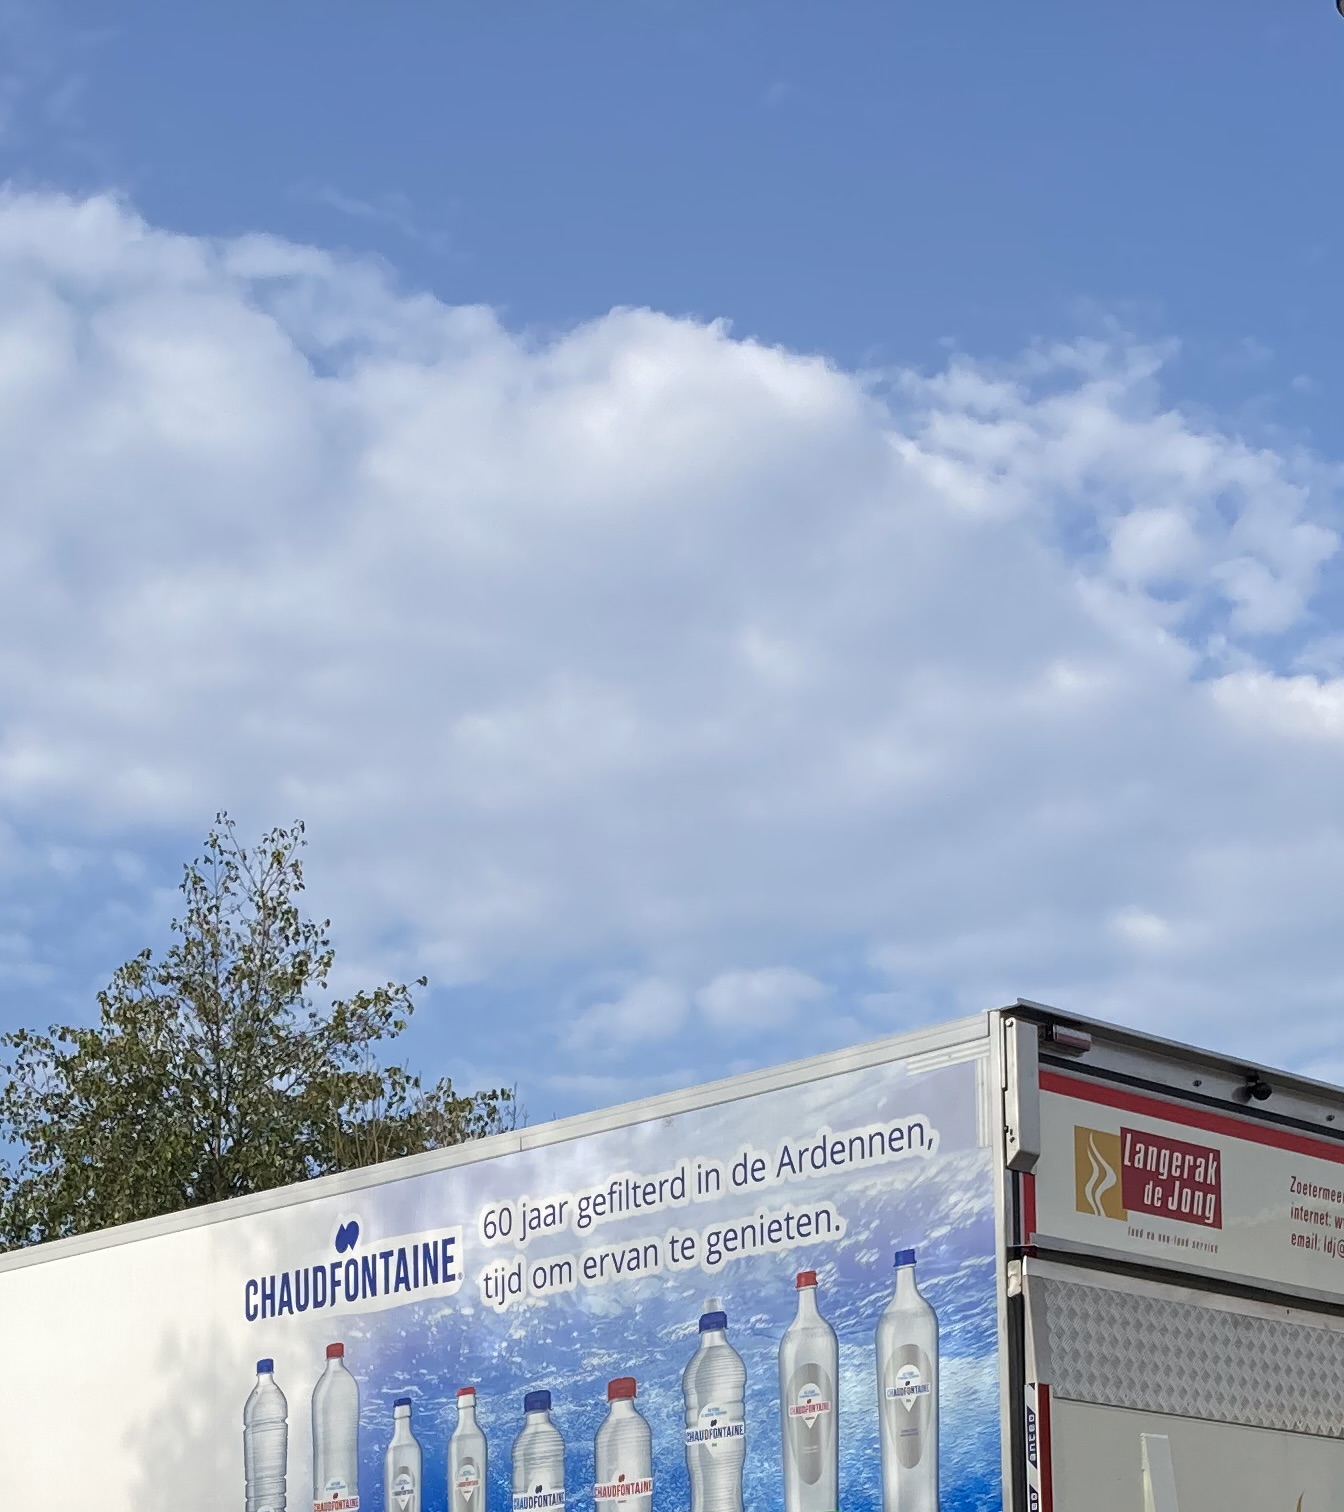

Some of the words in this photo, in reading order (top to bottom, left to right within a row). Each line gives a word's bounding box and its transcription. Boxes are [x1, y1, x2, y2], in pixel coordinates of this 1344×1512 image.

[1124, 1133, 1218, 1186] Langerak
[483, 1206, 512, 1240] 60
[519, 1197, 569, 1242] jaar
[577, 1167, 687, 1229] gefilterd
[697, 1163, 721, 1195] in
[731, 1153, 766, 1187] de
[776, 1122, 934, 1177] Ardennen,
[1143, 1180, 1162, 1207] de
[1168, 1180, 1216, 1224] Jong
[1290, 1202, 1332, 1227] internet:
[483, 1262, 523, 1307] tijd
[532, 1261, 572, 1290] om
[582, 1242, 658, 1280] ervan
[669, 1235, 695, 1263] te
[706, 1206, 842, 1264] genieten.
[1291, 1232, 1321, 1251] email:
[245, 1236, 456, 1322] CHAUDFONTAINE
[686, 1424, 744, 1442] CHAUDFONTAINE
[1029, 1414, 1037, 1462] anteo
[513, 1492, 565, 1510] CHAUDFONTAINE
[594, 1480, 652, 1498] CHAUDFONTAINE
